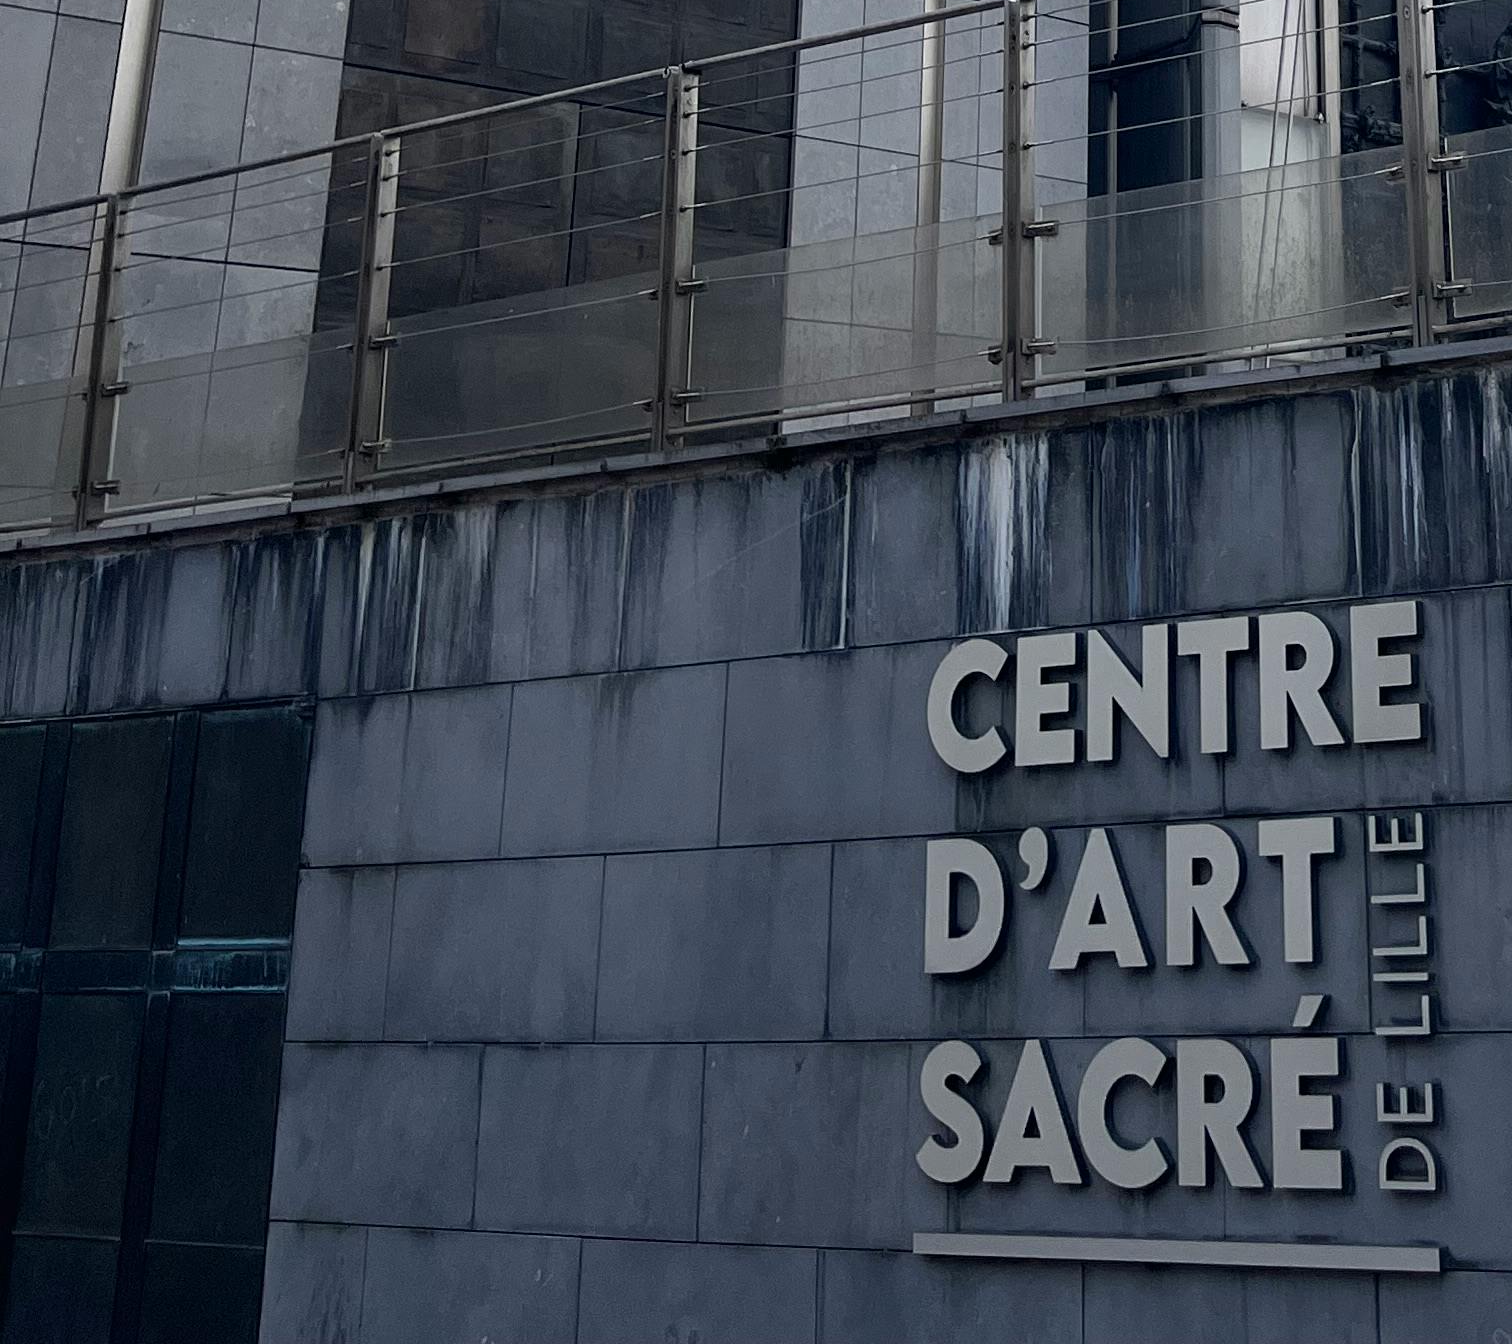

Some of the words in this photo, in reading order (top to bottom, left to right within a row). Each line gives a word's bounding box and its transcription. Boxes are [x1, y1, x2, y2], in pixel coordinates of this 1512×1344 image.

[927, 600, 1421, 773] CENTRE
[924, 816, 1335, 974] D'ART
[1368, 812, 1431, 1036] LILLE
[913, 994, 1342, 1189] SACRÉ
[1376, 1082, 1436, 1191] DE
